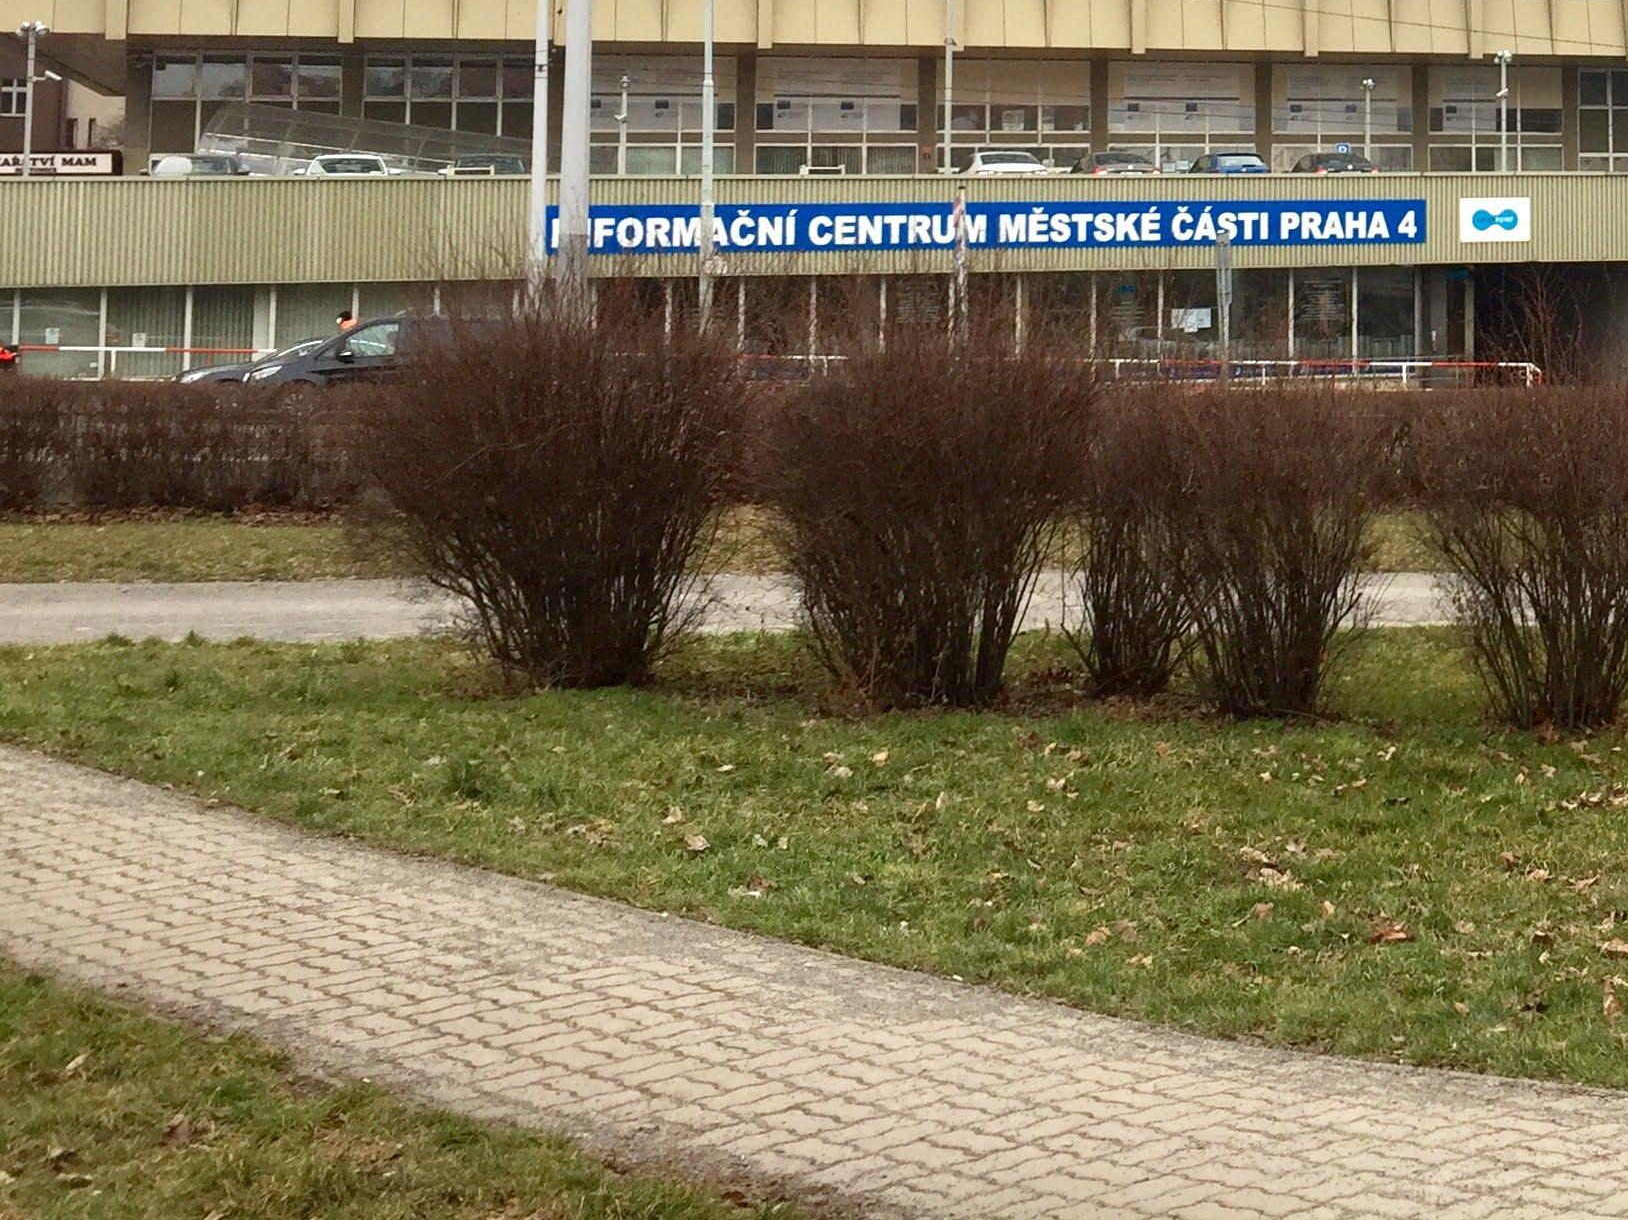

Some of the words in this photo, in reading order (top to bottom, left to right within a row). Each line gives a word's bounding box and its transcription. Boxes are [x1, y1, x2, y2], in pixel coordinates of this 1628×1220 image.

[61, 157, 97, 166] MAM
[551, 209, 799, 248] IFORMAČNÍ
[808, 214, 987, 245] CENTRUM
[1000, 206, 1161, 243] MĚSTSKÉ
[1171, 206, 1269, 240] ČÁSTI
[1280, 211, 1390, 240] PRAHA
[1398, 210, 1417, 239] 4
